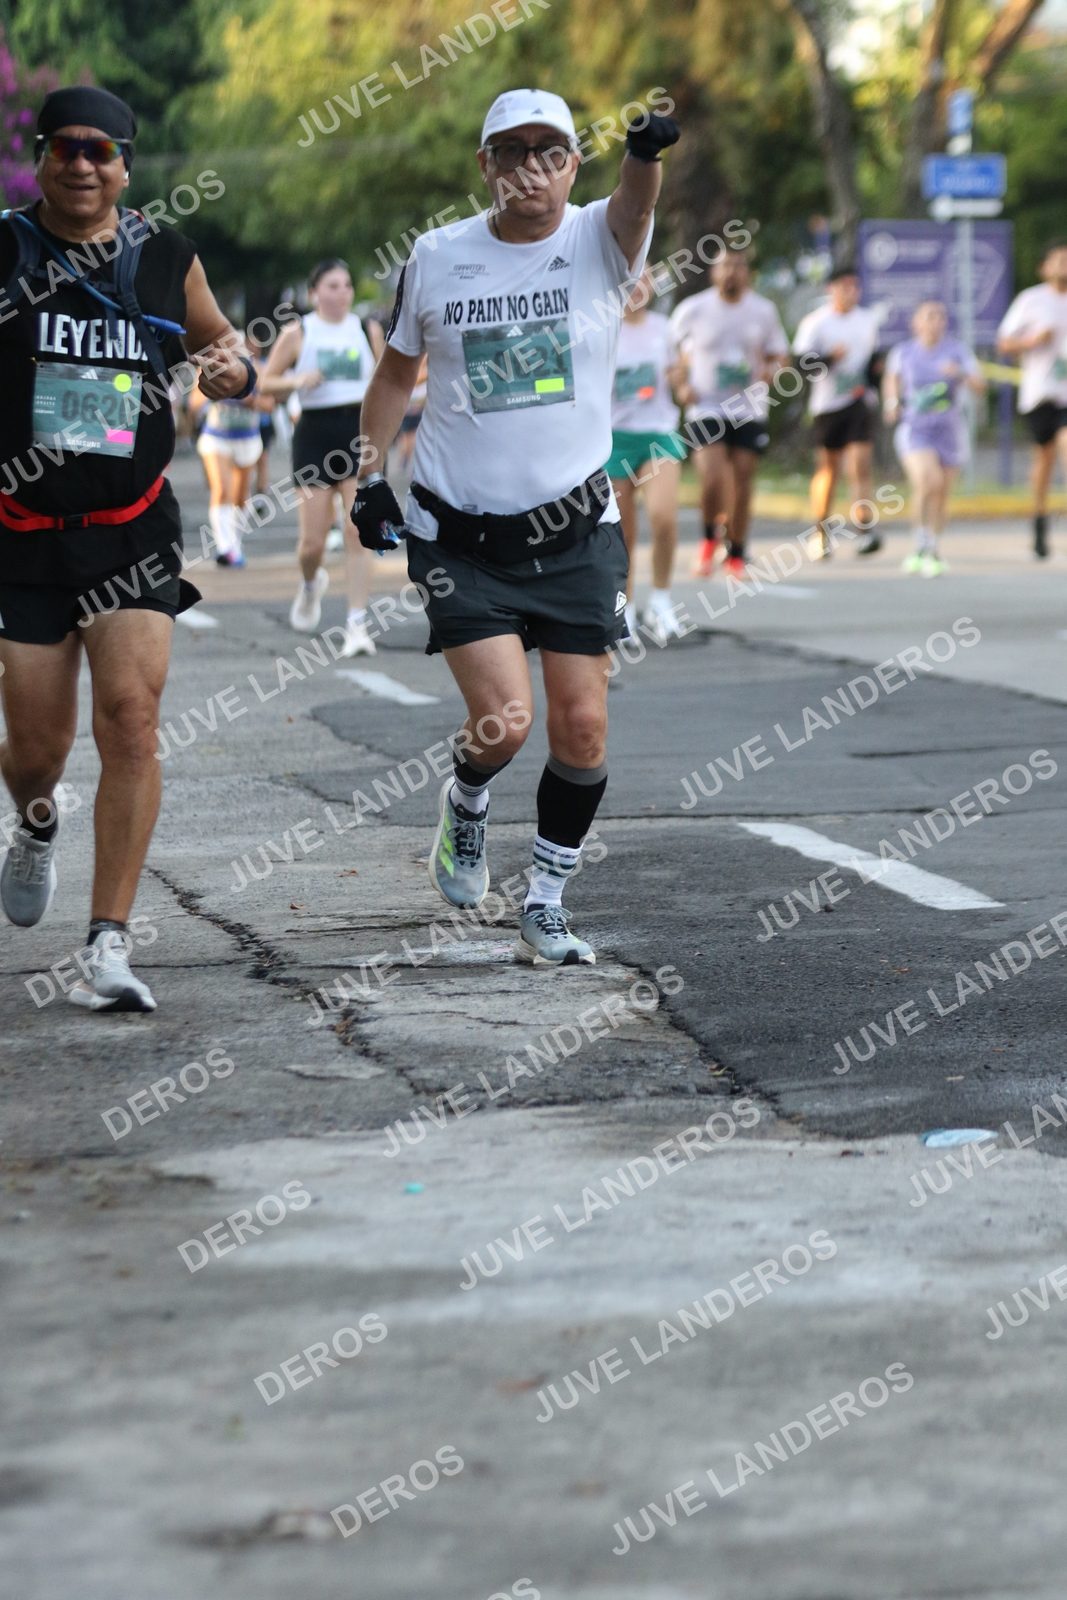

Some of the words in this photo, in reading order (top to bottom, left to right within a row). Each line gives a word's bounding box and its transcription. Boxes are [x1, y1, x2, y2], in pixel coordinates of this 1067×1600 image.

[443, 301, 464, 326] NO
[467, 296, 503, 324] PAIN
[506, 294, 528, 321] NO
[532, 288, 569, 318] GAIN
[39, 312, 149, 361] LEYEND
[506, 394, 541, 405] SAMSUNG
